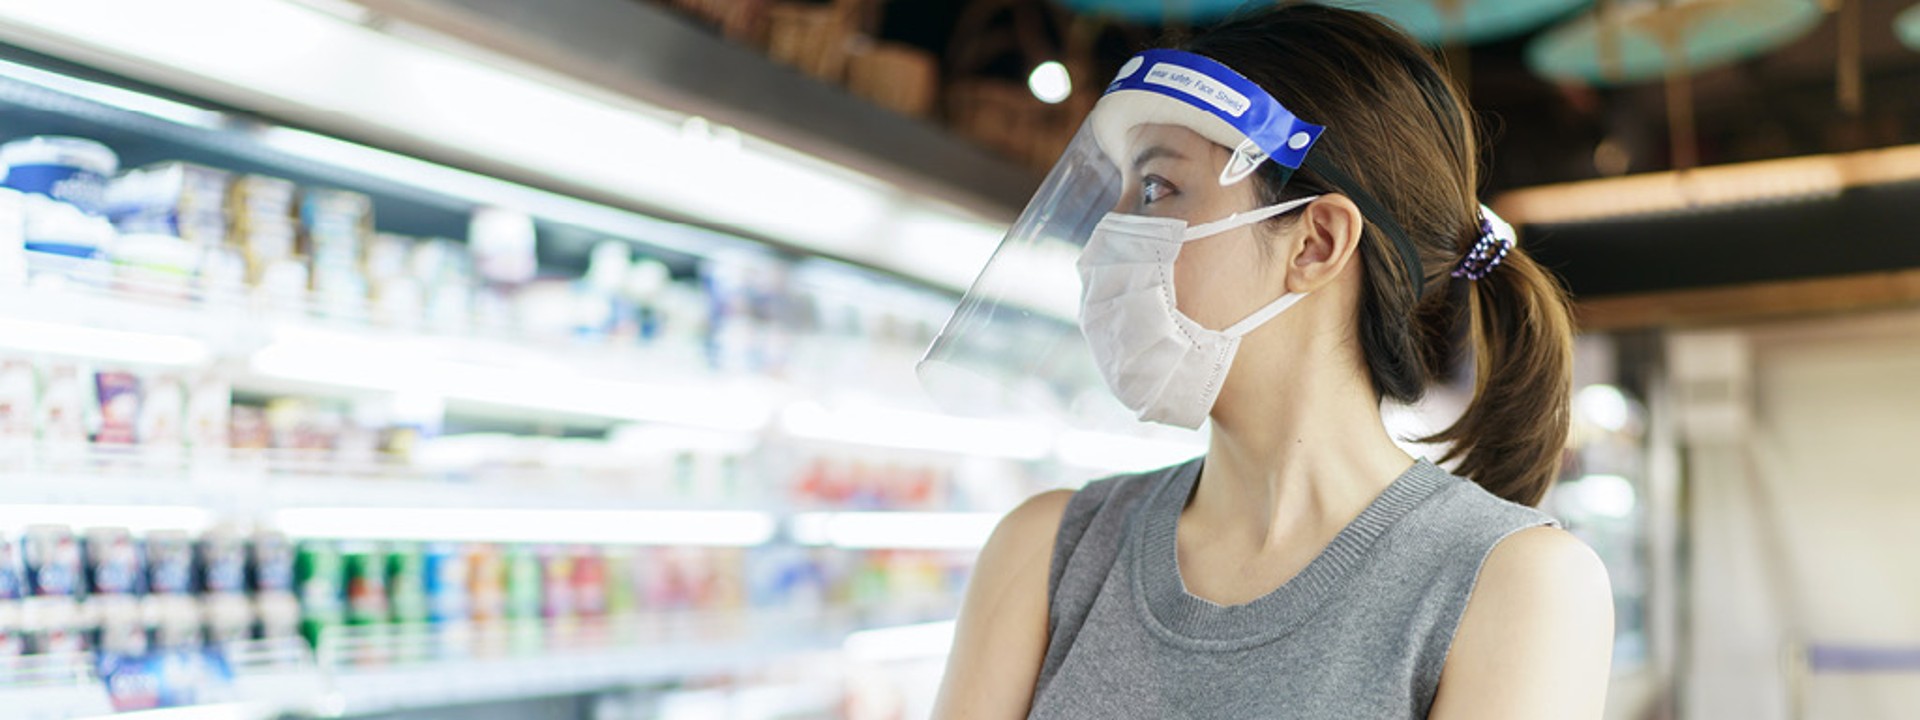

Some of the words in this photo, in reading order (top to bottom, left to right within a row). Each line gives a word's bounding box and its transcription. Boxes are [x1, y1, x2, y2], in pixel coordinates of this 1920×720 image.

[1169, 73, 1192, 86] safety
[1194, 80, 1214, 94] Face
[1215, 90, 1243, 111] Shield
